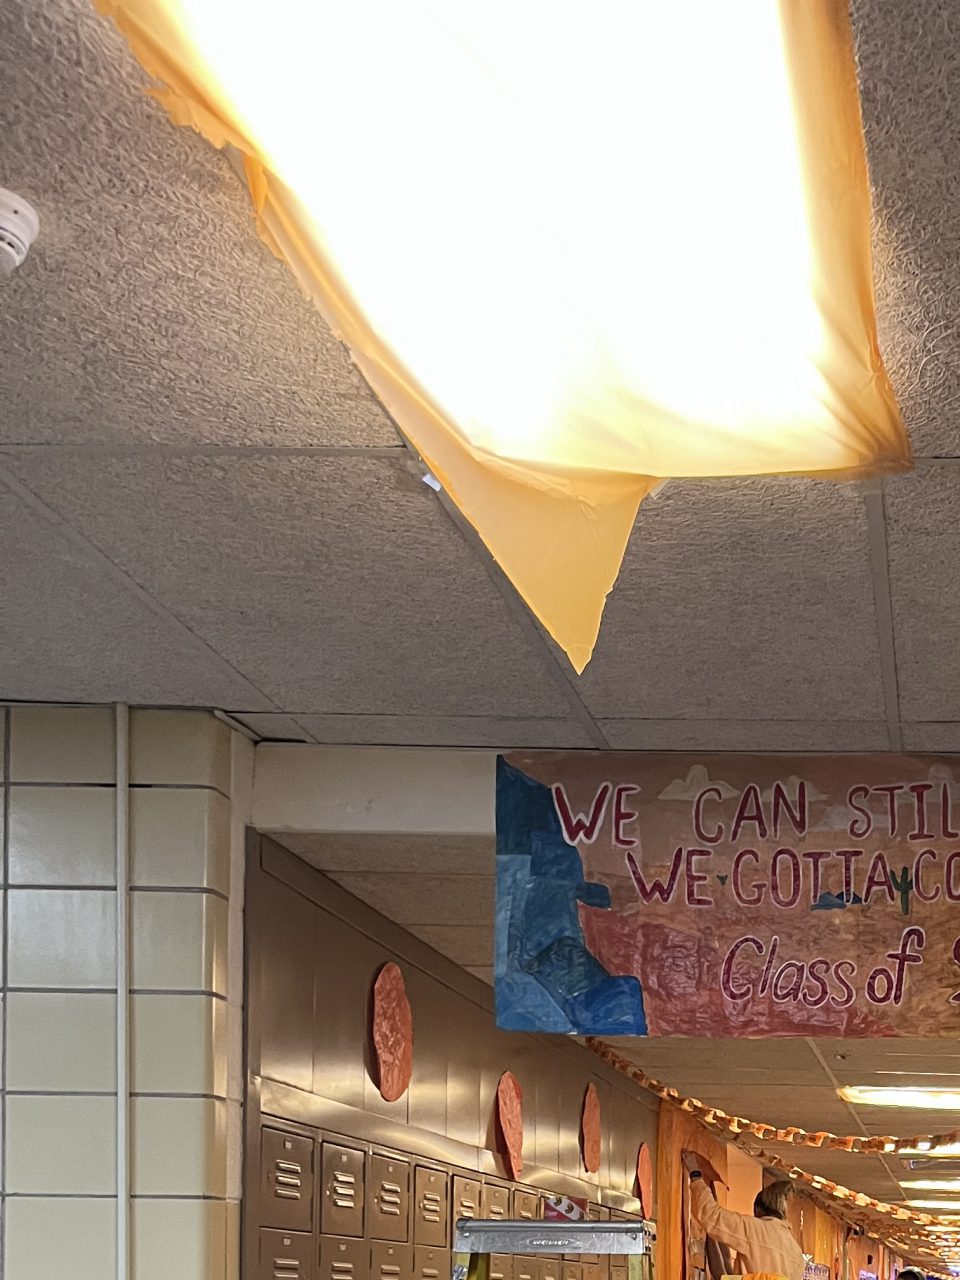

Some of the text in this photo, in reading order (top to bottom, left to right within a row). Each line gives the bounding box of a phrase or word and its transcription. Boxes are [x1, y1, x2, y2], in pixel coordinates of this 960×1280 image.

[553, 782, 641, 847] WE
[692, 780, 807, 845] CAN
[626, 846, 714, 908] WE
[731, 847, 896, 908] GOTTA
[721, 935, 857, 1008] Class
[866, 926, 926, 1006] of
